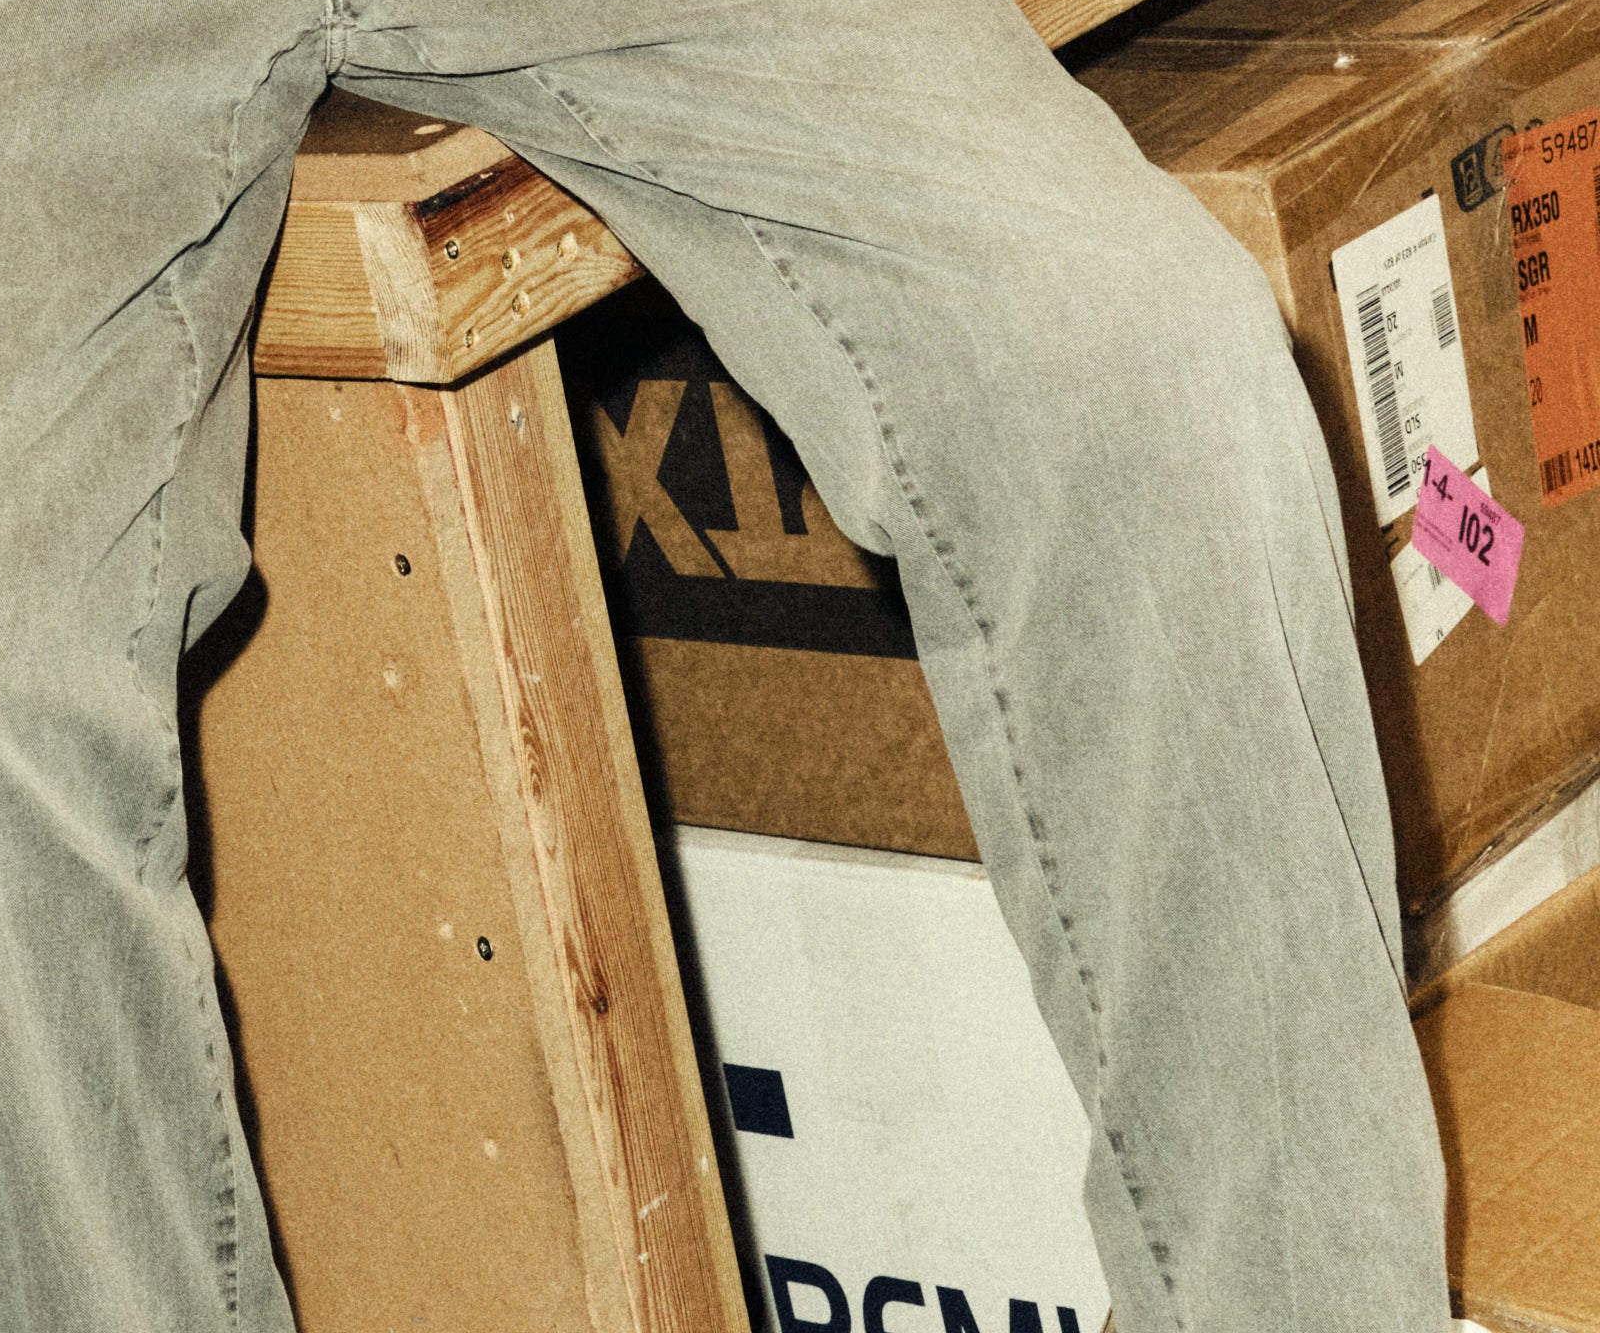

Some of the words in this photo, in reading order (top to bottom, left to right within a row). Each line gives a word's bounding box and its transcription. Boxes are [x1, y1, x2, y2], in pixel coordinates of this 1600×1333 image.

[1541, 119, 1598, 164] 59487
[1511, 190, 1560, 234] RX350
[1518, 250, 1551, 292] SGR
[1386, 314, 1398, 333] 20
[1523, 313, 1538, 348] M
[1529, 377, 1543, 407] 20
[1405, 413, 1421, 434] SLD
